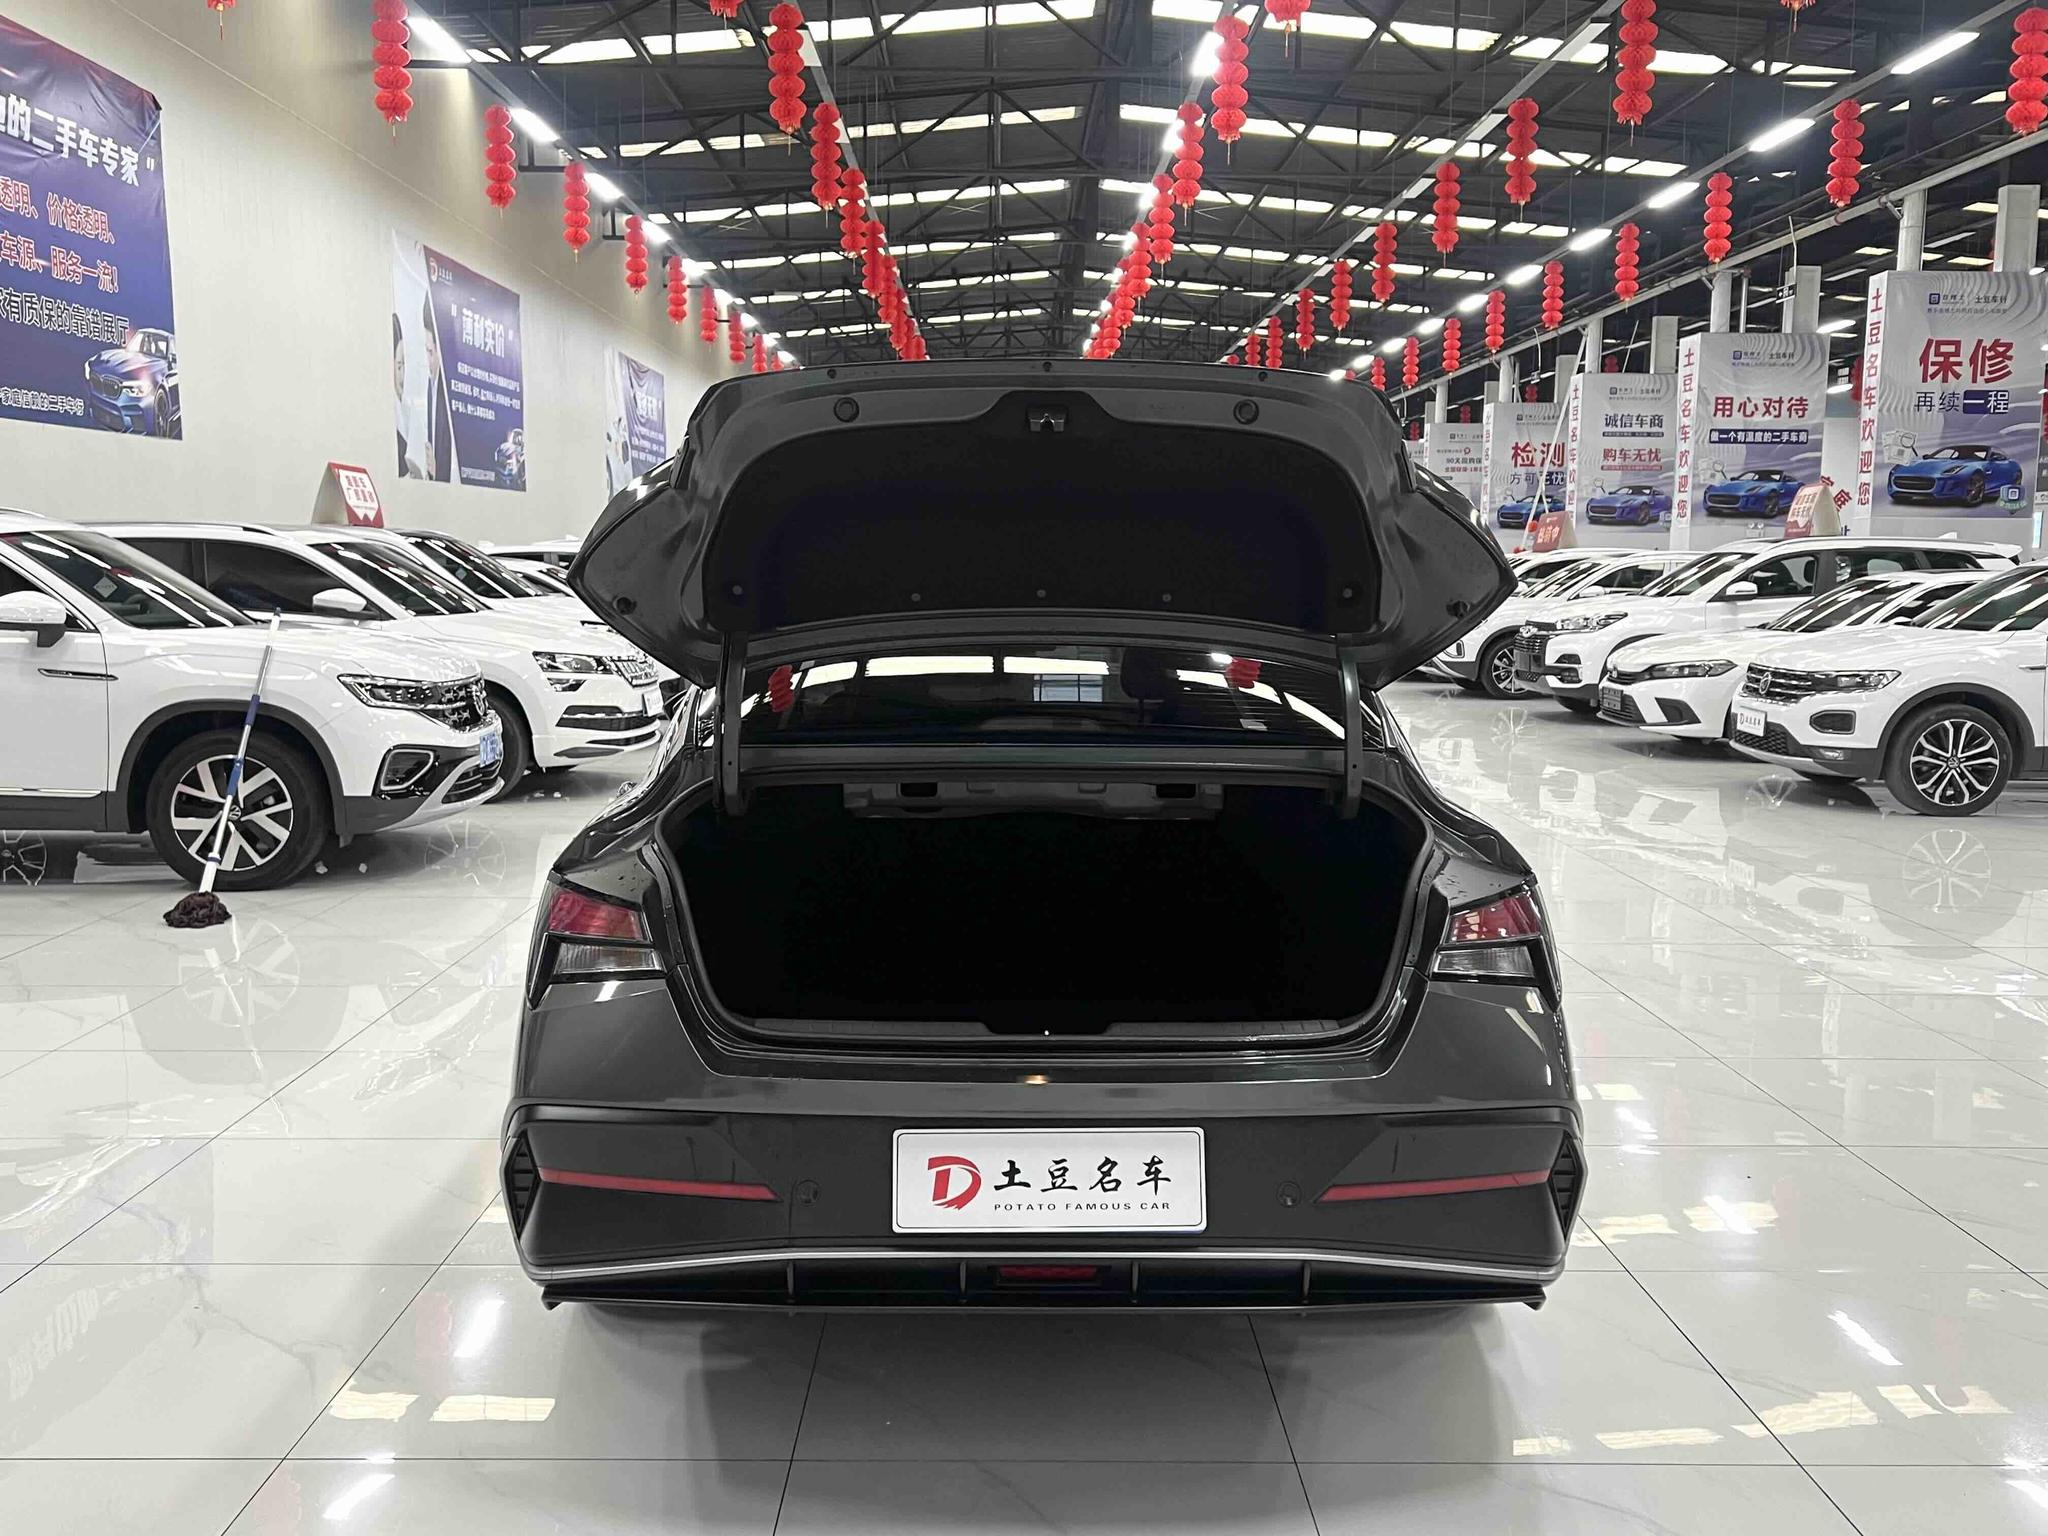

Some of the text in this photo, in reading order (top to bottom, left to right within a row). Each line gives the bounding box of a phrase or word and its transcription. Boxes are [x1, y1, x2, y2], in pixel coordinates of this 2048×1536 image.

[1919, 337, 2014, 384] 保修
[0, 386, 84, 416] 家庭信赖的二手车行
[1713, 396, 1809, 419] 用心对待
[1857, 288, 1883, 505] 土豆名车欢迎您
[1914, 390, 2009, 413] 再续一程
[1604, 413, 1665, 429] 诚信车商
[1676, 347, 1695, 519] 土豆名车欢迎您
[1710, 431, 1808, 443] 做一个有温度的二手车商
[1511, 442, 1565, 468] 检测
[1603, 447, 1662, 462] 购车无忧
[993, 1155, 1172, 1196] 土豆名车
[994, 1202, 1171, 1211] POTATO FAMOUS CAR
